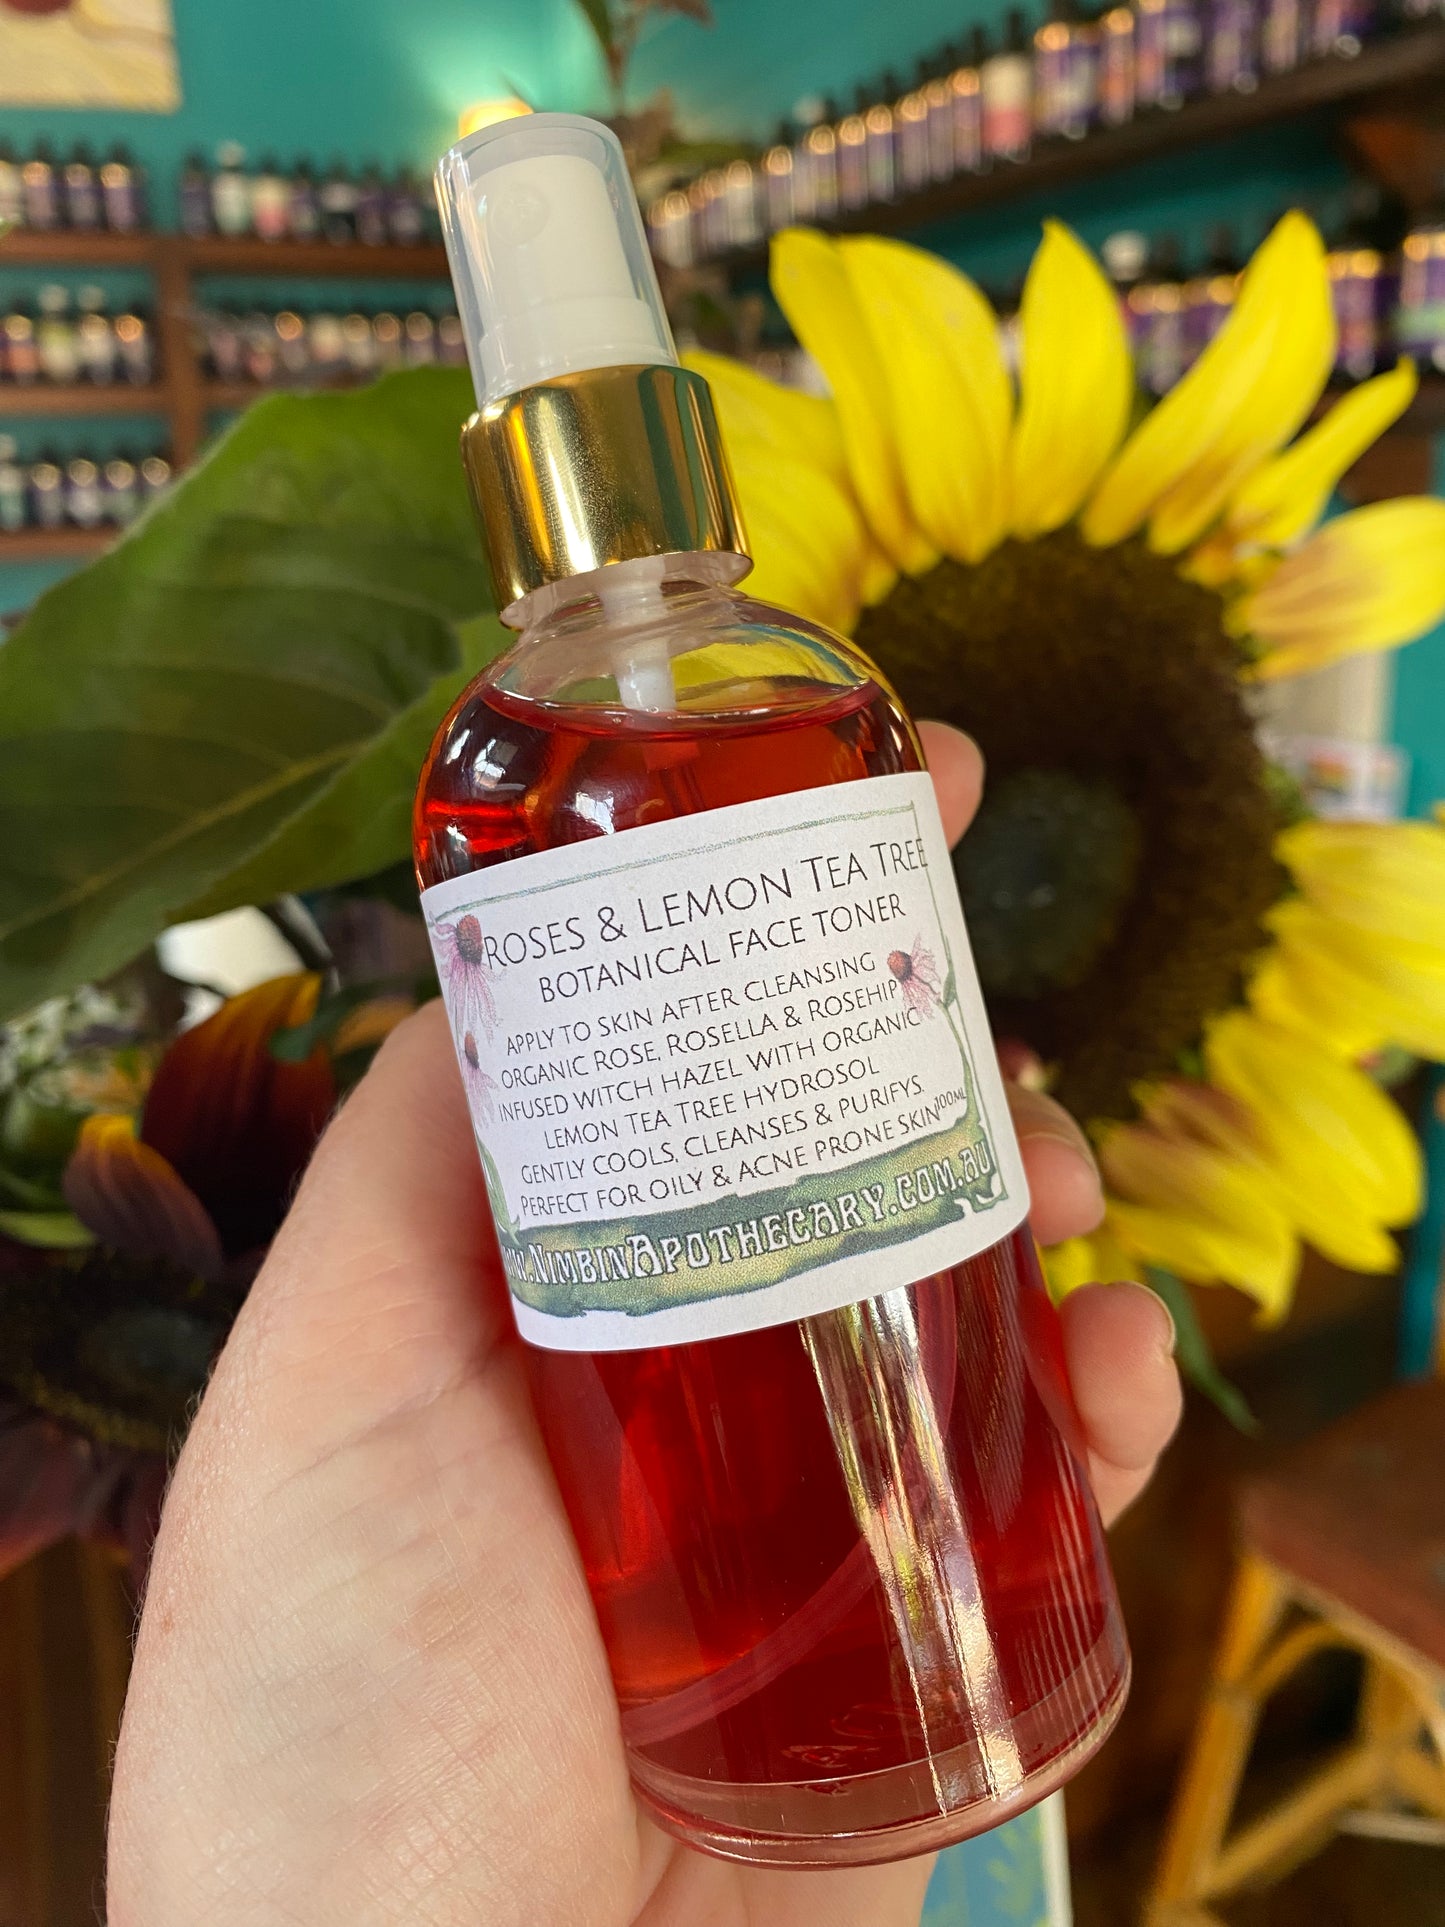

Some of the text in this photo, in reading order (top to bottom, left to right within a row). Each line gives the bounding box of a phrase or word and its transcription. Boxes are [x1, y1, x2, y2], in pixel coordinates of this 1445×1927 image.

[484, 838, 929, 970] ROSES & LEMON TEA TREE
[538, 893, 906, 1003] BOTANICAL FACE TONER
[501, 1055, 589, 1089] ORGANIC
[666, 1013, 779, 1057] ROSELLA
[784, 1005, 803, 1028] &
[808, 979, 897, 1022] ROSEHIP
[507, 952, 876, 1056] APPLY TO SKIN AFTER CLEANSING
[499, 1006, 921, 1122] INFUSED WITCH HAZEL WITH ORGANIC
[544, 1056, 880, 1150] LEMON TEA TREE HYDROSOL
[520, 1103, 940, 1217] PERFECT FOR OILY & ACNE PRONE SKIN
[521, 1158, 585, 1185] GENTLY
[684, 1110, 808, 1157] CLEANSES
[815, 1103, 833, 1126] &
[838, 1074, 925, 1119] PURIFYS.
